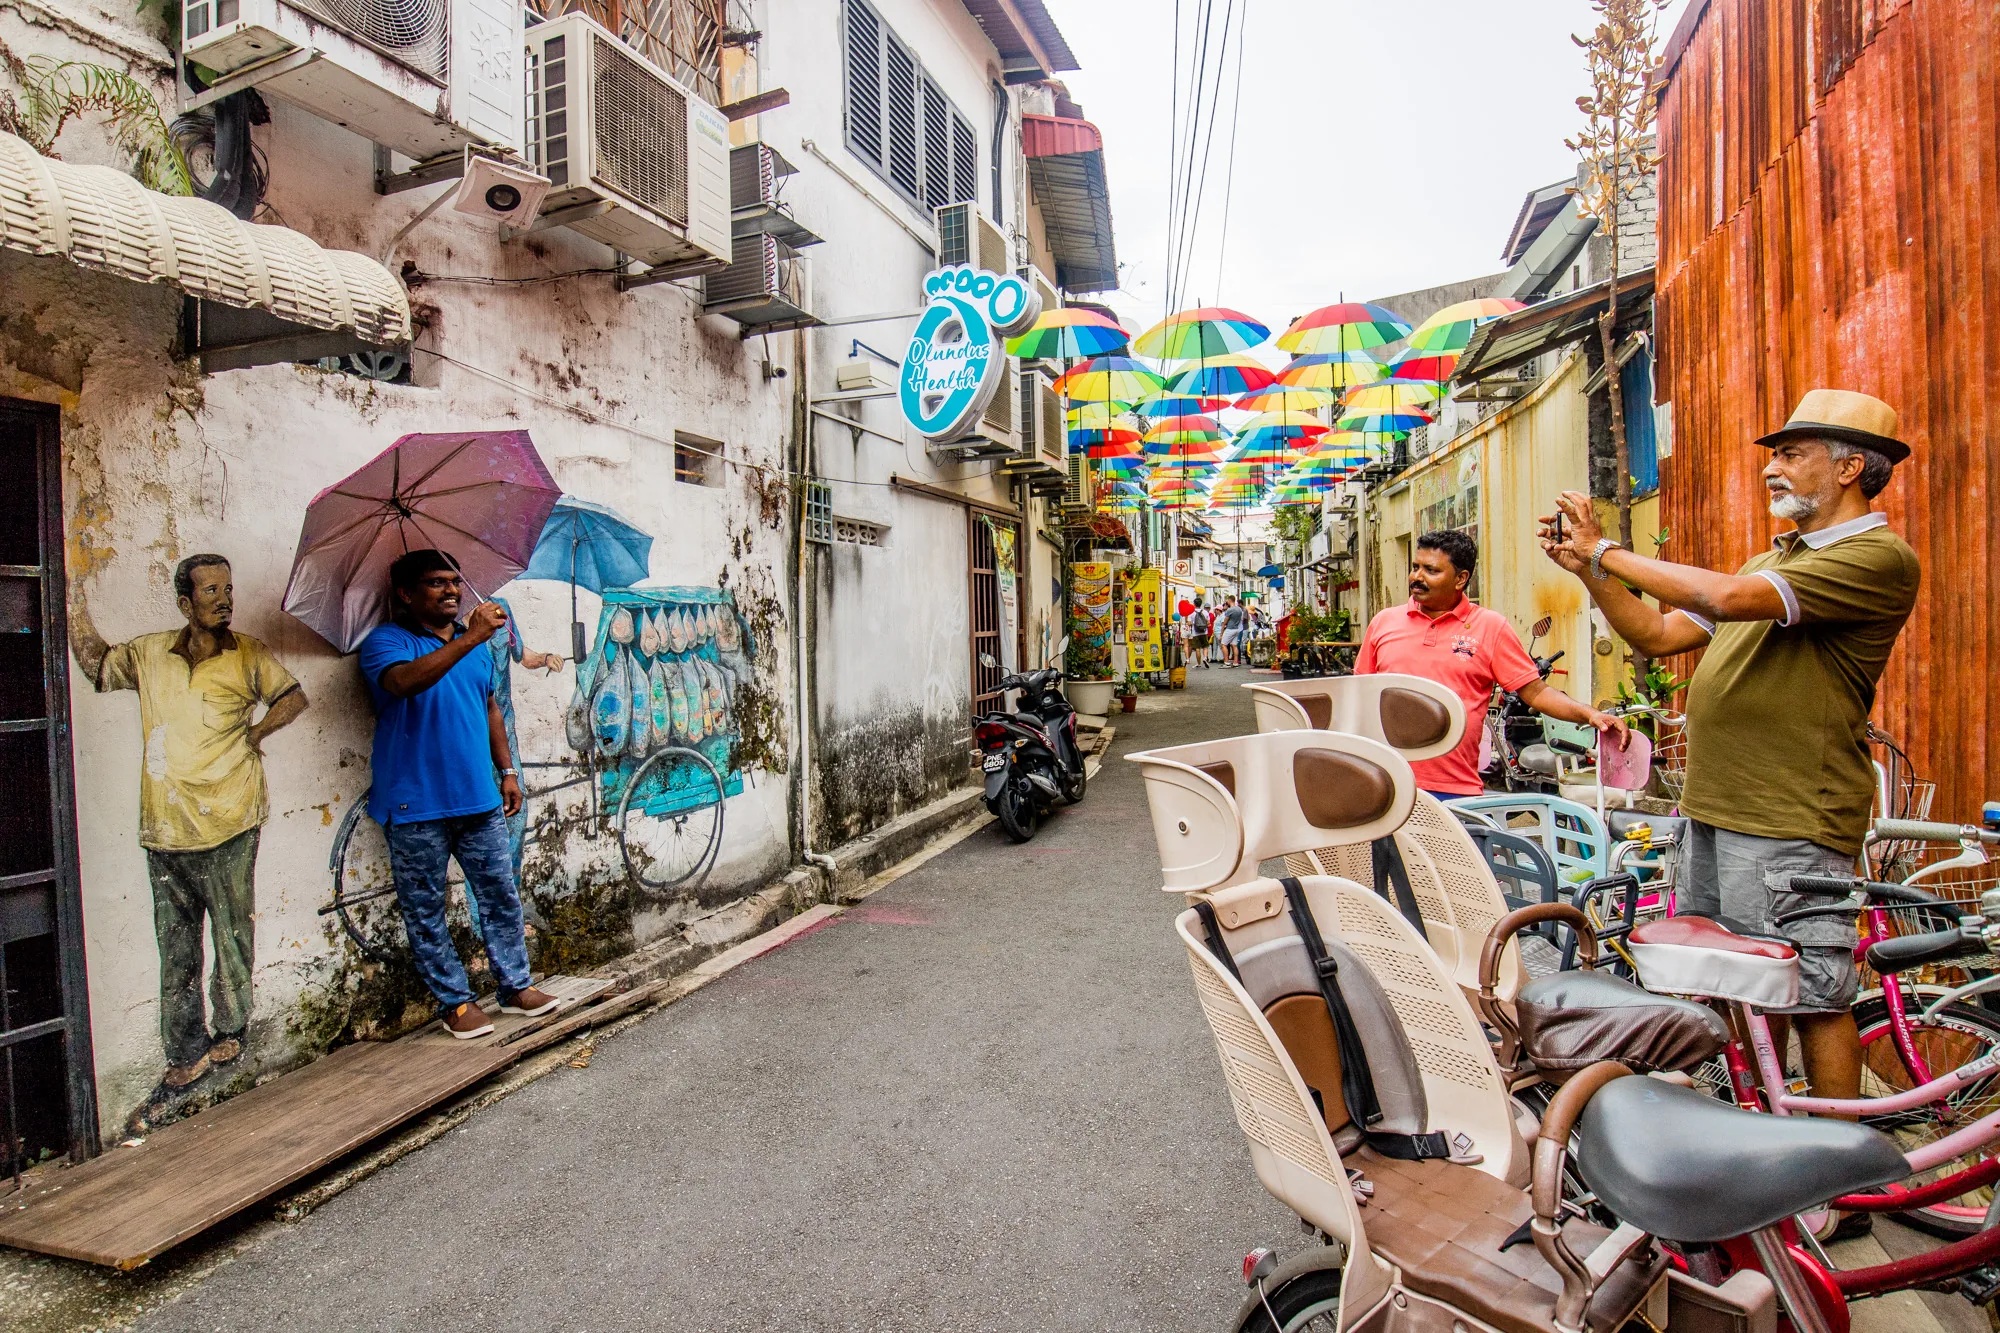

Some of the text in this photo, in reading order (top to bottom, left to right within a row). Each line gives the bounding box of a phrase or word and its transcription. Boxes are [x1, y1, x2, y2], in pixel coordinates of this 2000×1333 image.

[699, 110, 725, 133] DAIKIN
[908, 337, 990, 365] Olundus
[908, 365, 979, 392] Health
[986, 753, 1003, 763] PNE
